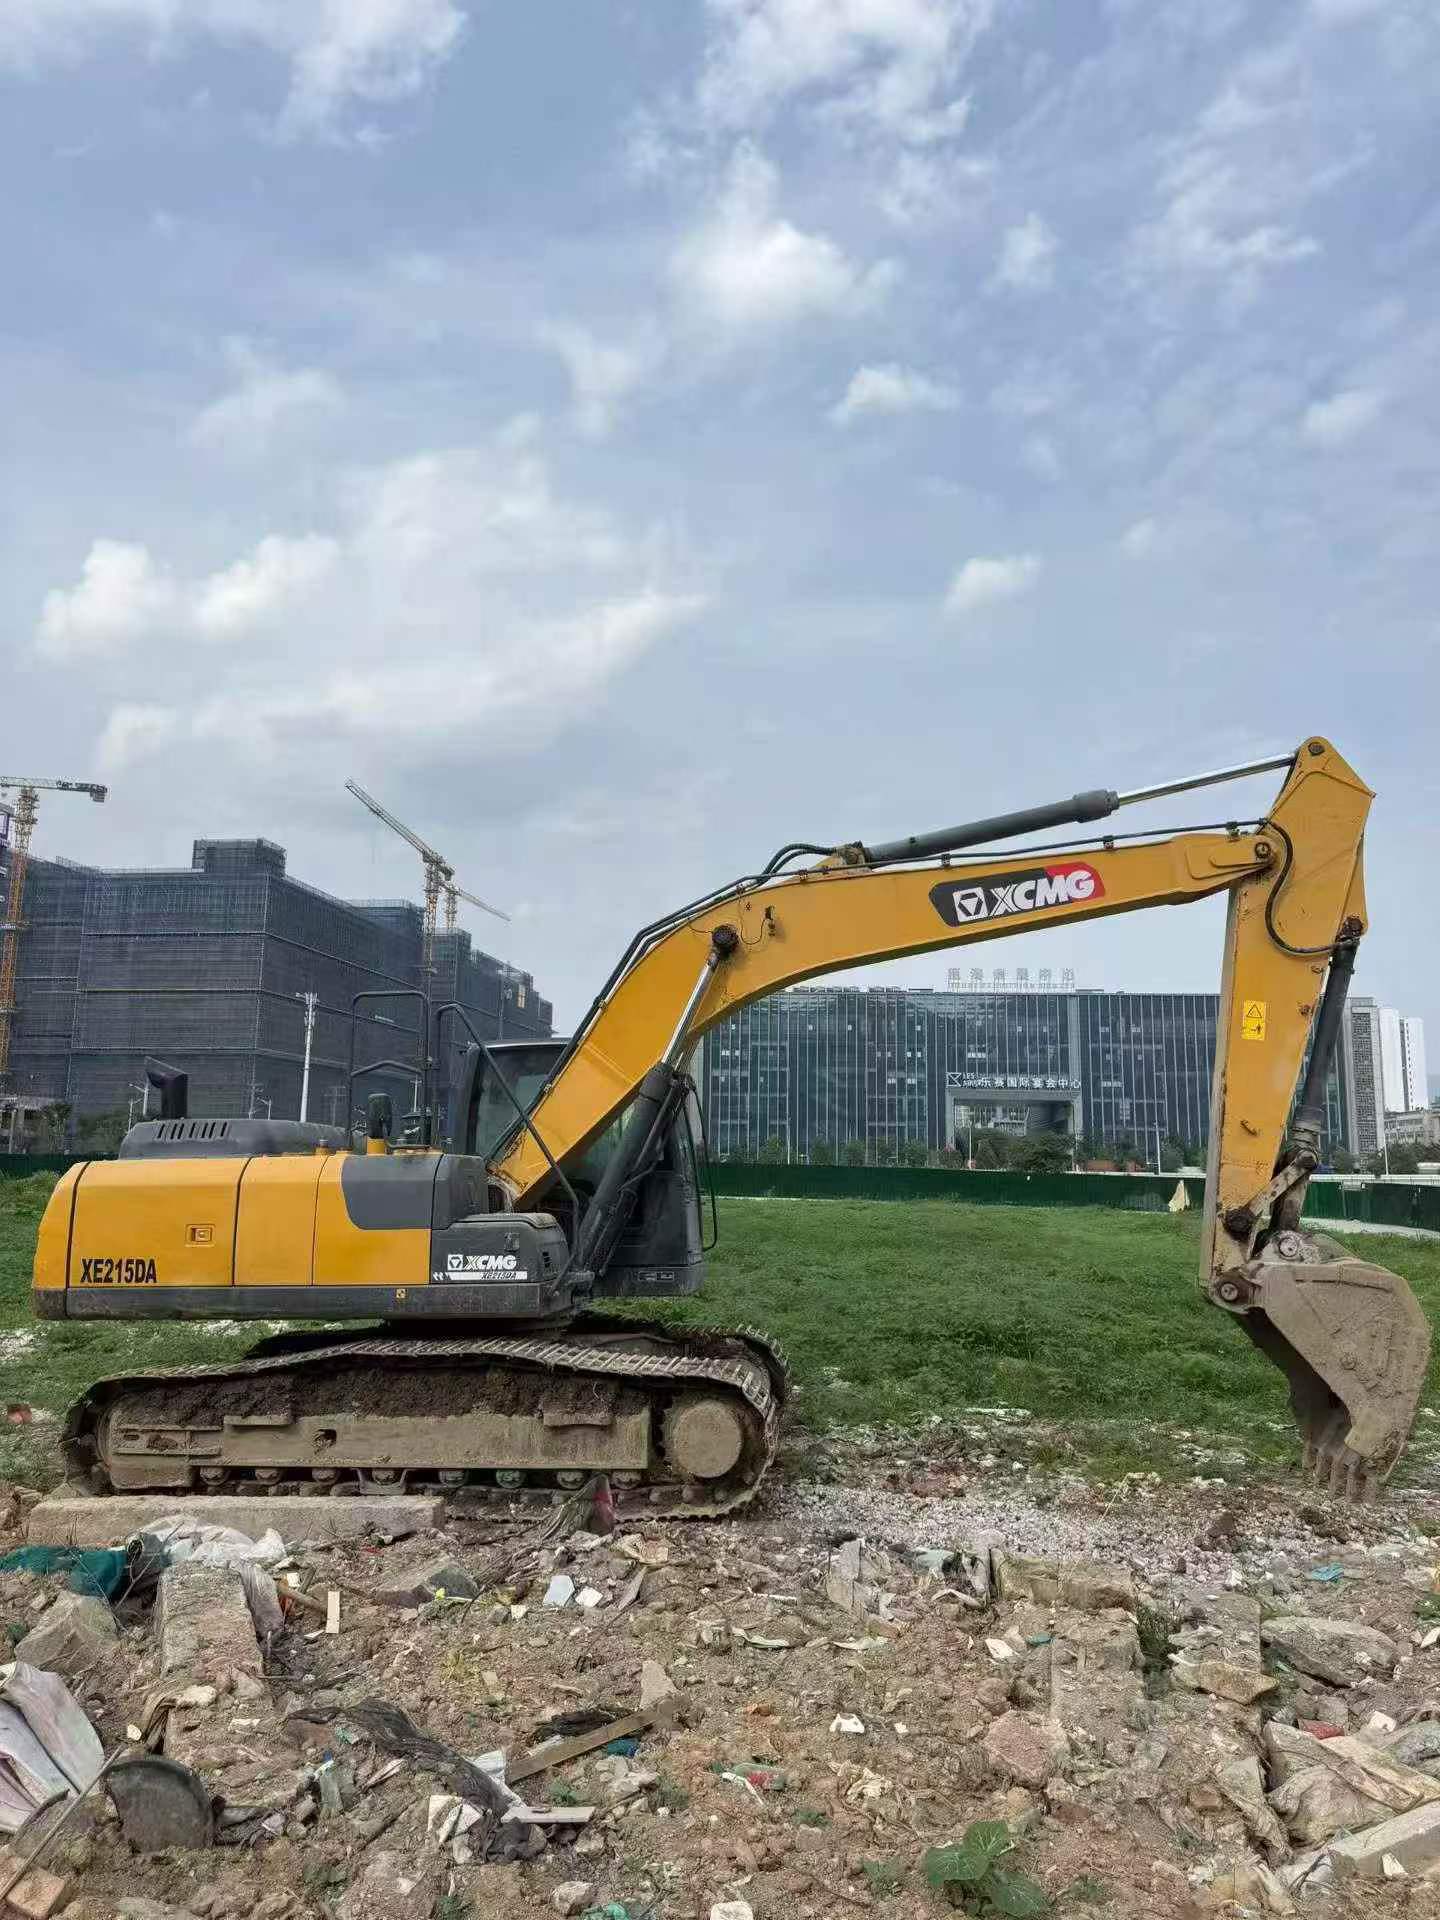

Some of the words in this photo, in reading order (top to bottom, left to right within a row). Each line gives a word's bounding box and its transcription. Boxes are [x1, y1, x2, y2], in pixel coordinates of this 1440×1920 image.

[988, 869, 1095, 917] XCMG
[80, 1257, 158, 1284] XE215DA
[463, 1254, 518, 1271] XCMG
